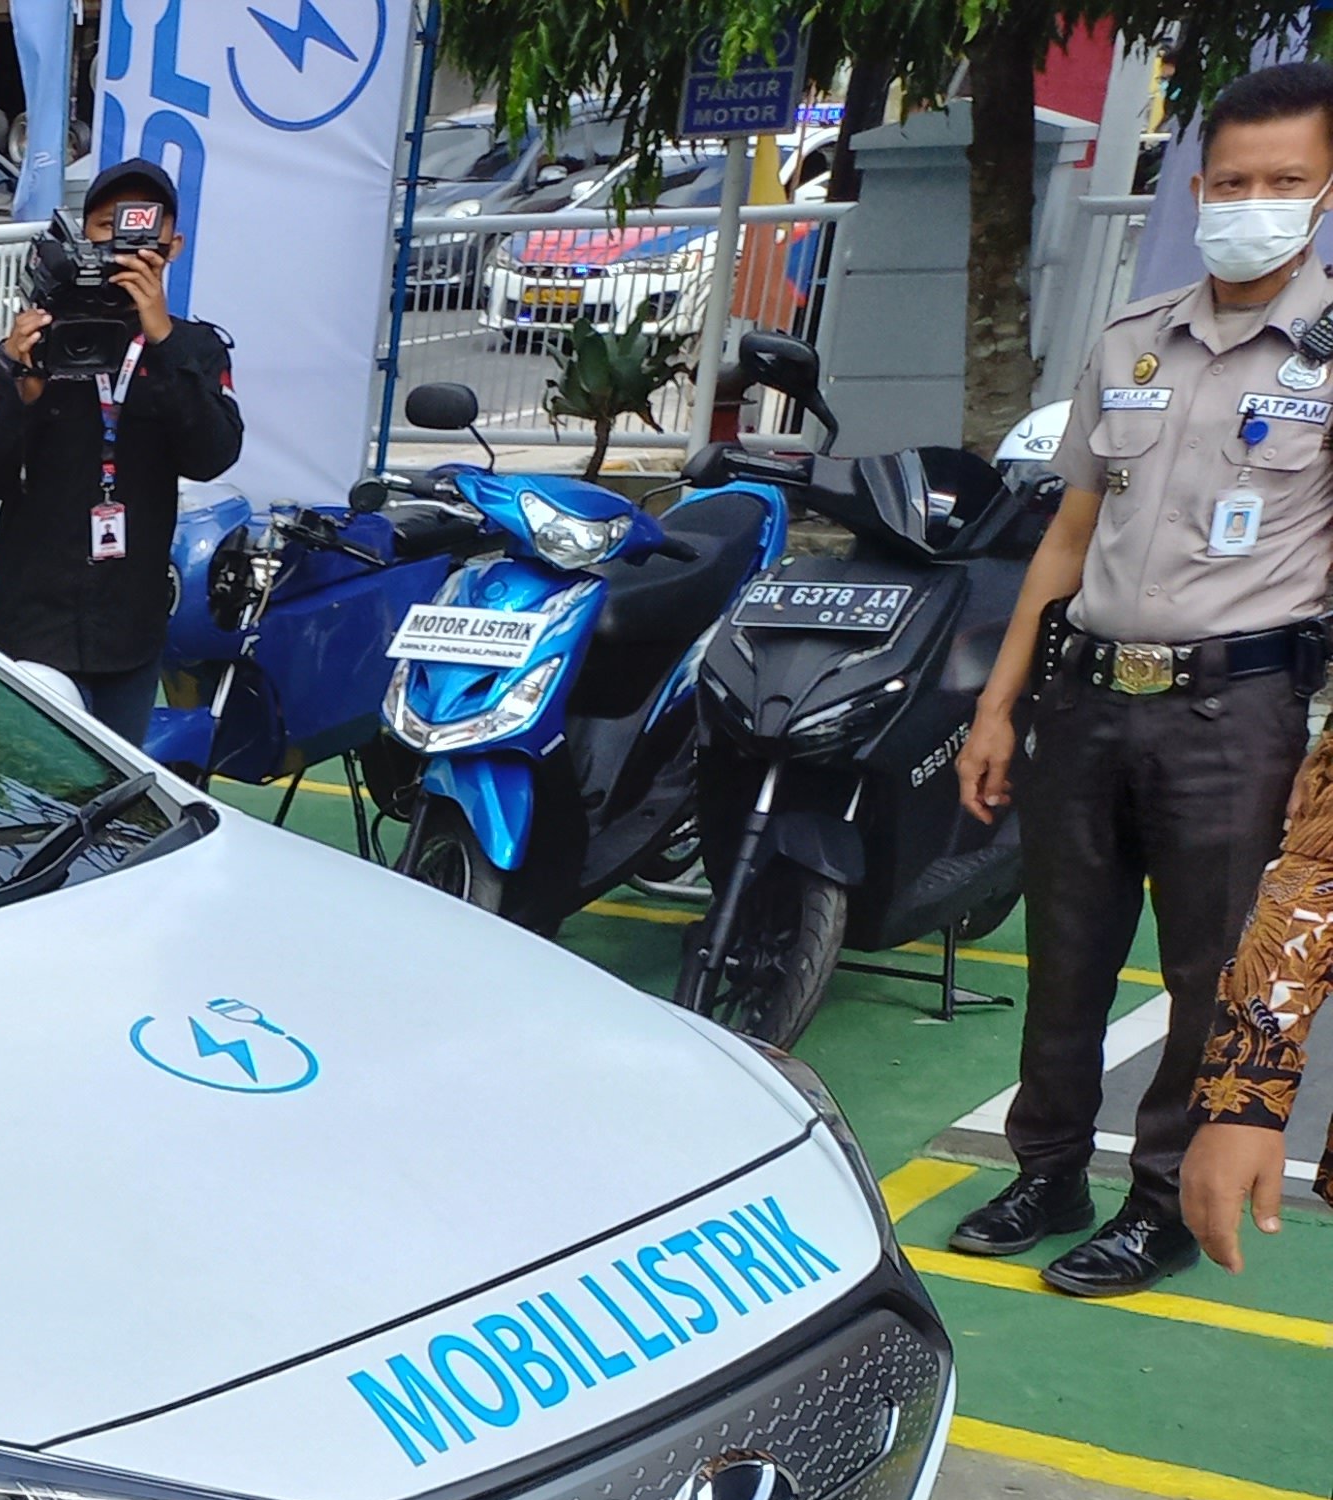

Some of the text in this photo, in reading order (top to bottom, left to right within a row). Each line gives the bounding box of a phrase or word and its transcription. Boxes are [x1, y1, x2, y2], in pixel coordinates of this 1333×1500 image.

[696, 79, 780, 102] PARKIR
[693, 105, 777, 126] MOTOR
[1248, 397, 1327, 419] SATPAM
[791, 587, 855, 606] 6378
[864, 590, 900, 608] AA
[407, 613, 537, 641] MOTOR LISTRIK
[346, 1196, 841, 1468] MOBIL LISTRIK
